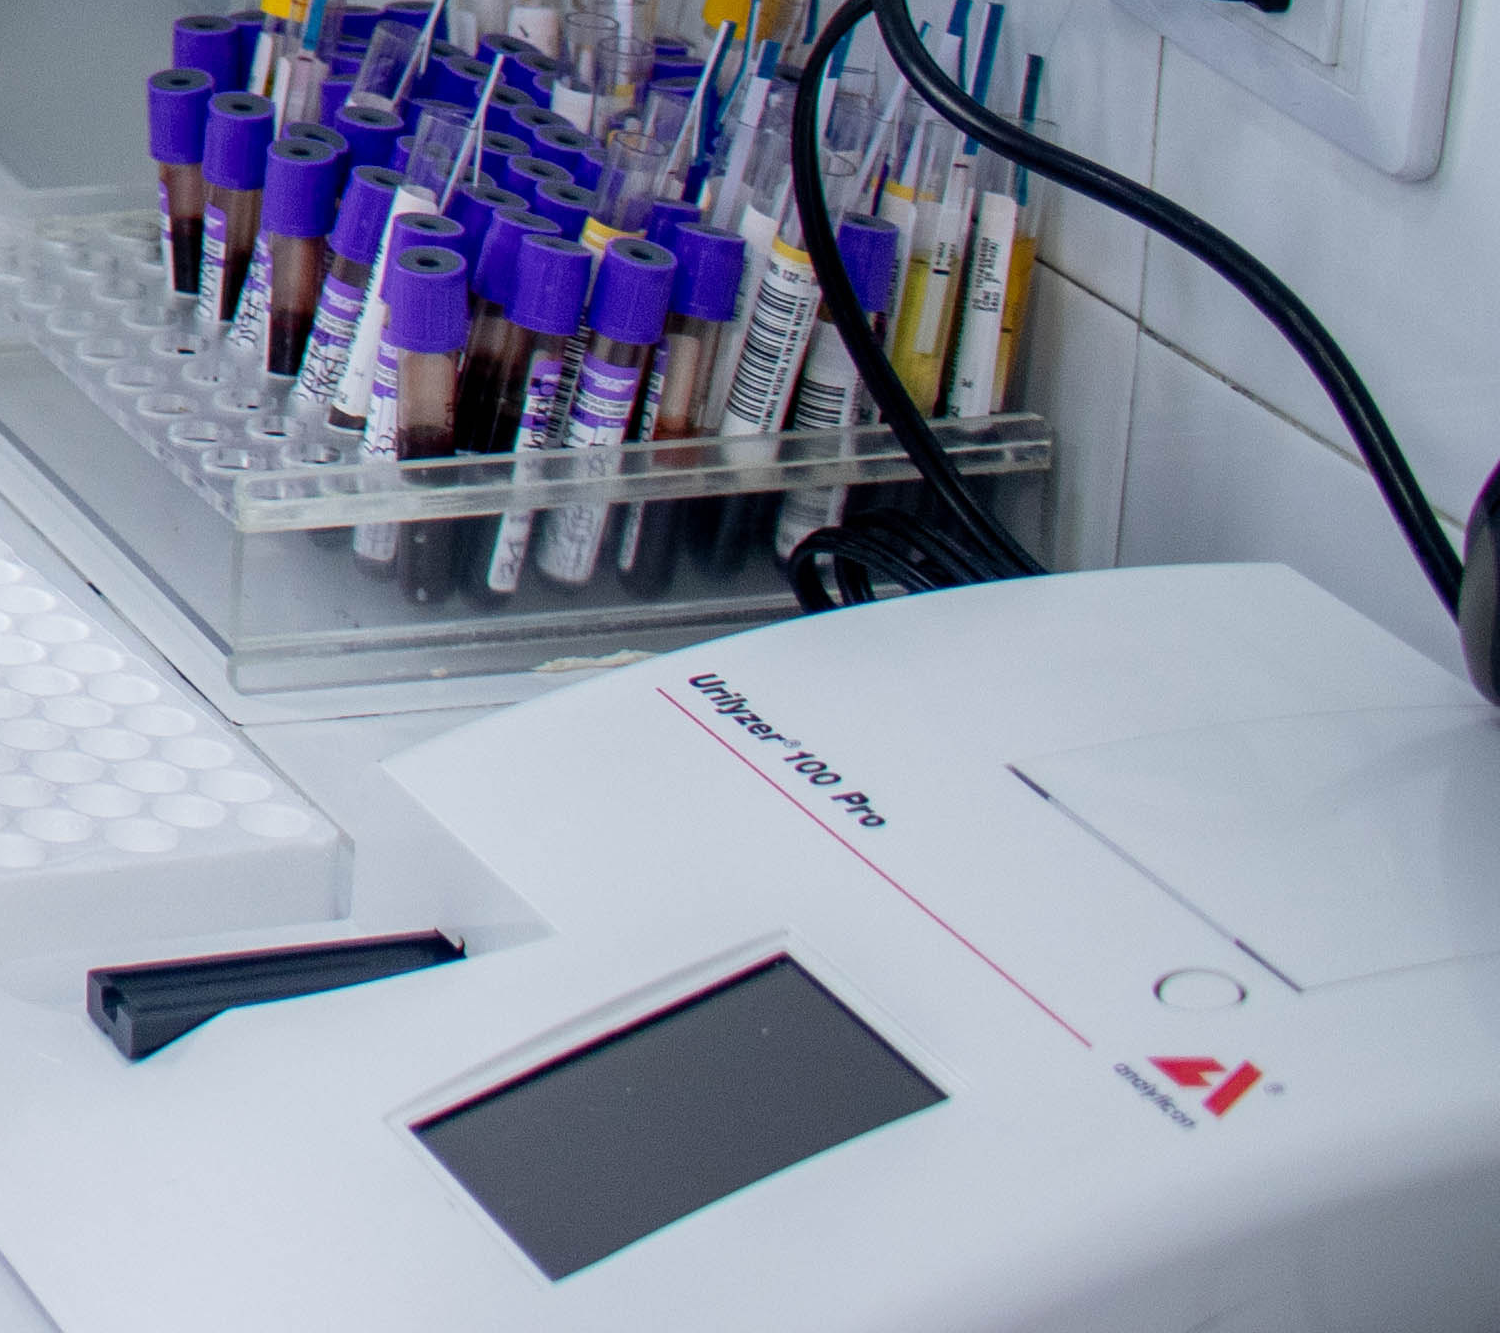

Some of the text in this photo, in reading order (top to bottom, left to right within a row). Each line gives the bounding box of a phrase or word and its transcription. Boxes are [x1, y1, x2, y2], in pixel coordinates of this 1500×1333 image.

[783, 751, 842, 786] 100
[829, 791, 886, 827] Pro
[1113, 1063, 1196, 1130] analyticon
